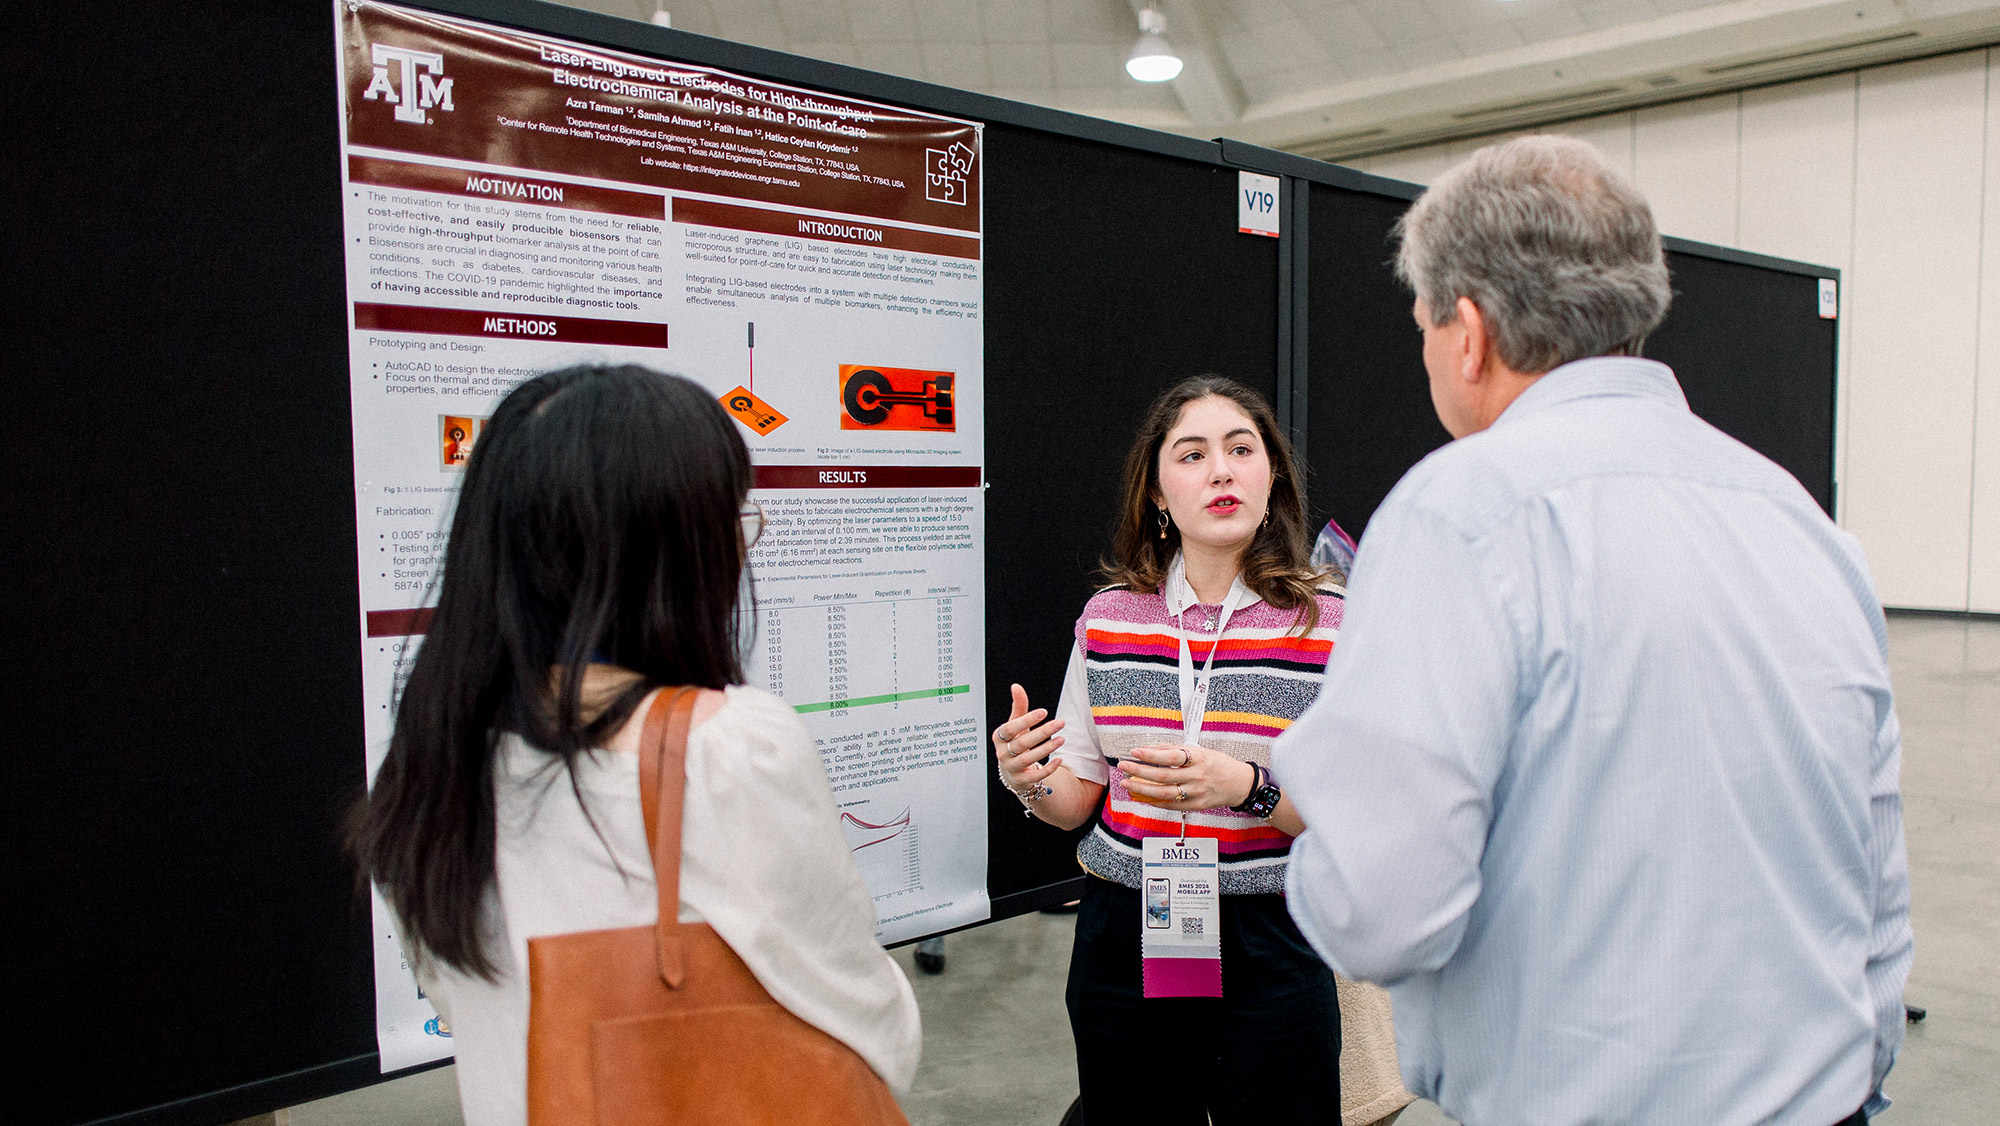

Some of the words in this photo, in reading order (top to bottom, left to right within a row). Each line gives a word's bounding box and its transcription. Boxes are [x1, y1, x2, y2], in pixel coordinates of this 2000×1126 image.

[539, 45, 666, 84] Laser-Engraved
[668, 71, 745, 98] Electrodes
[747, 86, 768, 102] for
[769, 90, 876, 123] High-throughput
[552, 67, 680, 105] Electrochemical
[682, 92, 744, 116] Analysis
[746, 105, 761, 120] at
[762, 107, 785, 124] the
[787, 111, 868, 139] Point-of-care
[565, 97, 587, 109] Azra
[588, 100, 623, 114] Tarman
[637, 109, 670, 122] Samiha
[670, 115, 701, 128] Ahmed
[714, 122, 734, 133] Fatih
[735, 126, 753, 137] Inan
[764, 131, 789, 143] Hatice
[789, 135, 815, 148] Ceylan
[816, 140, 851, 153] Koydemir
[527, 120, 538, 130] for
[538, 122, 568, 134] Remote
[569, 127, 593, 138] Health
[594, 131, 641, 146] Technologies
[641, 140, 655, 148] and
[655, 142, 686, 153] Systems,
[687, 146, 708, 156] Texas
[708, 150, 724, 158] A&M
[725, 152, 762, 166] Engineering
[762, 158, 796, 170] Experiment
[796, 163, 818, 174] Station,
[818, 167, 840, 178] College
[840, 171, 861, 181] Station,
[862, 174, 872, 183] TX,
[872, 176, 891, 186] 77843,
[891, 179, 905, 188] USA.
[610, 124, 619, 132] of
[619, 124, 657, 138] Biomedical
[657, 131, 698, 145] Engineering,
[699, 137, 719, 148] Texas
[719, 141, 736, 151] A&M
[736, 144, 768, 157] University,
[768, 149, 792, 161] College
[792, 153, 814, 164] Station,
[814, 157, 825, 166] TX,
[825, 159, 845, 169] 77843,
[845, 162, 860, 171] USA.
[640, 155, 654, 165] Lab
[654, 159, 681, 169] website:
[465, 176, 563, 200] MOTIVATION
[1245, 189, 1273, 213] V19
[367, 190, 387, 202] The
[391, 195, 442, 207] motivation
[446, 200, 460, 209] for
[463, 202, 481, 212] this
[484, 206, 510, 217] study
[514, 209, 542, 219] stems
[545, 211, 566, 222] from
[569, 215, 583, 224] the
[587, 218, 608, 227] need
[611, 219, 623, 228] for
[627, 222, 661, 233] reliable,
[367, 208, 443, 222] cost-effective,
[449, 216, 469, 225] and
[476, 219, 505, 231] easily
[512, 224, 563, 235] producible
[569, 228, 620, 241] biosensors
[625, 235, 641, 244] that
[646, 238, 662, 246] can
[798, 220, 882, 241] INTRODUCTION
[685, 252, 726, 262] well-suited
[727, 255, 738, 264] for
[739, 258, 785, 269] point-of-care
[786, 261, 796, 270] for
[797, 264, 816, 272] quick
[817, 266, 830, 274] and
[832, 268, 861, 277] accurate
[861, 270, 891, 280] detection
[892, 273, 899, 281] of
[900, 274, 935, 285] biomarkers.
[370, 280, 381, 289] of
[384, 281, 420, 295] having
[423, 286, 478, 297] accessible
[481, 290, 500, 299] and
[502, 293, 563, 304] reproducible
[565, 296, 613, 308] diagnostic
[615, 301, 640, 310] tools.
[483, 317, 557, 335] METHODS
[369, 336, 426, 350] Prototyping
[428, 341, 447, 350] and
[450, 341, 485, 353] Design:
[384, 361, 431, 372] AutoCAD
[434, 363, 444, 373] to
[445, 364, 478, 375] design
[480, 365, 495, 375] the
[819, 470, 866, 482] RESULTS
[753, 498, 770, 507] from
[784, 497, 803, 506] study
[851, 496, 885, 504] successful
[886, 496, 920, 504] application
[920, 495, 927, 503] of
[927, 495, 967, 503] laser-induced
[375, 506, 433, 515] Fabrication:
[392, 543, 429, 554] Testing
[432, 543, 443, 552] of
[756, 538, 775, 547] short
[776, 538, 812, 546] fabrication
[813, 537, 828, 545] time
[829, 536, 837, 544] of
[838, 536, 852, 544] 2:39
[882, 534, 896, 542] This
[897, 535, 922, 543] process
[922, 533, 944, 542] yielded
[392, 556, 406, 565] for
[393, 569, 429, 578] Screen
[394, 580, 422, 590] 5874)
[830, 701, 848, 709] 8.00%
[829, 732, 863, 743] conducted
[866, 730, 879, 738] with
[891, 727, 895, 735] 5
[898, 725, 910, 733] mM
[913, 720, 950, 731] ferrocyanide
[1162, 848, 1200, 860] BMES
